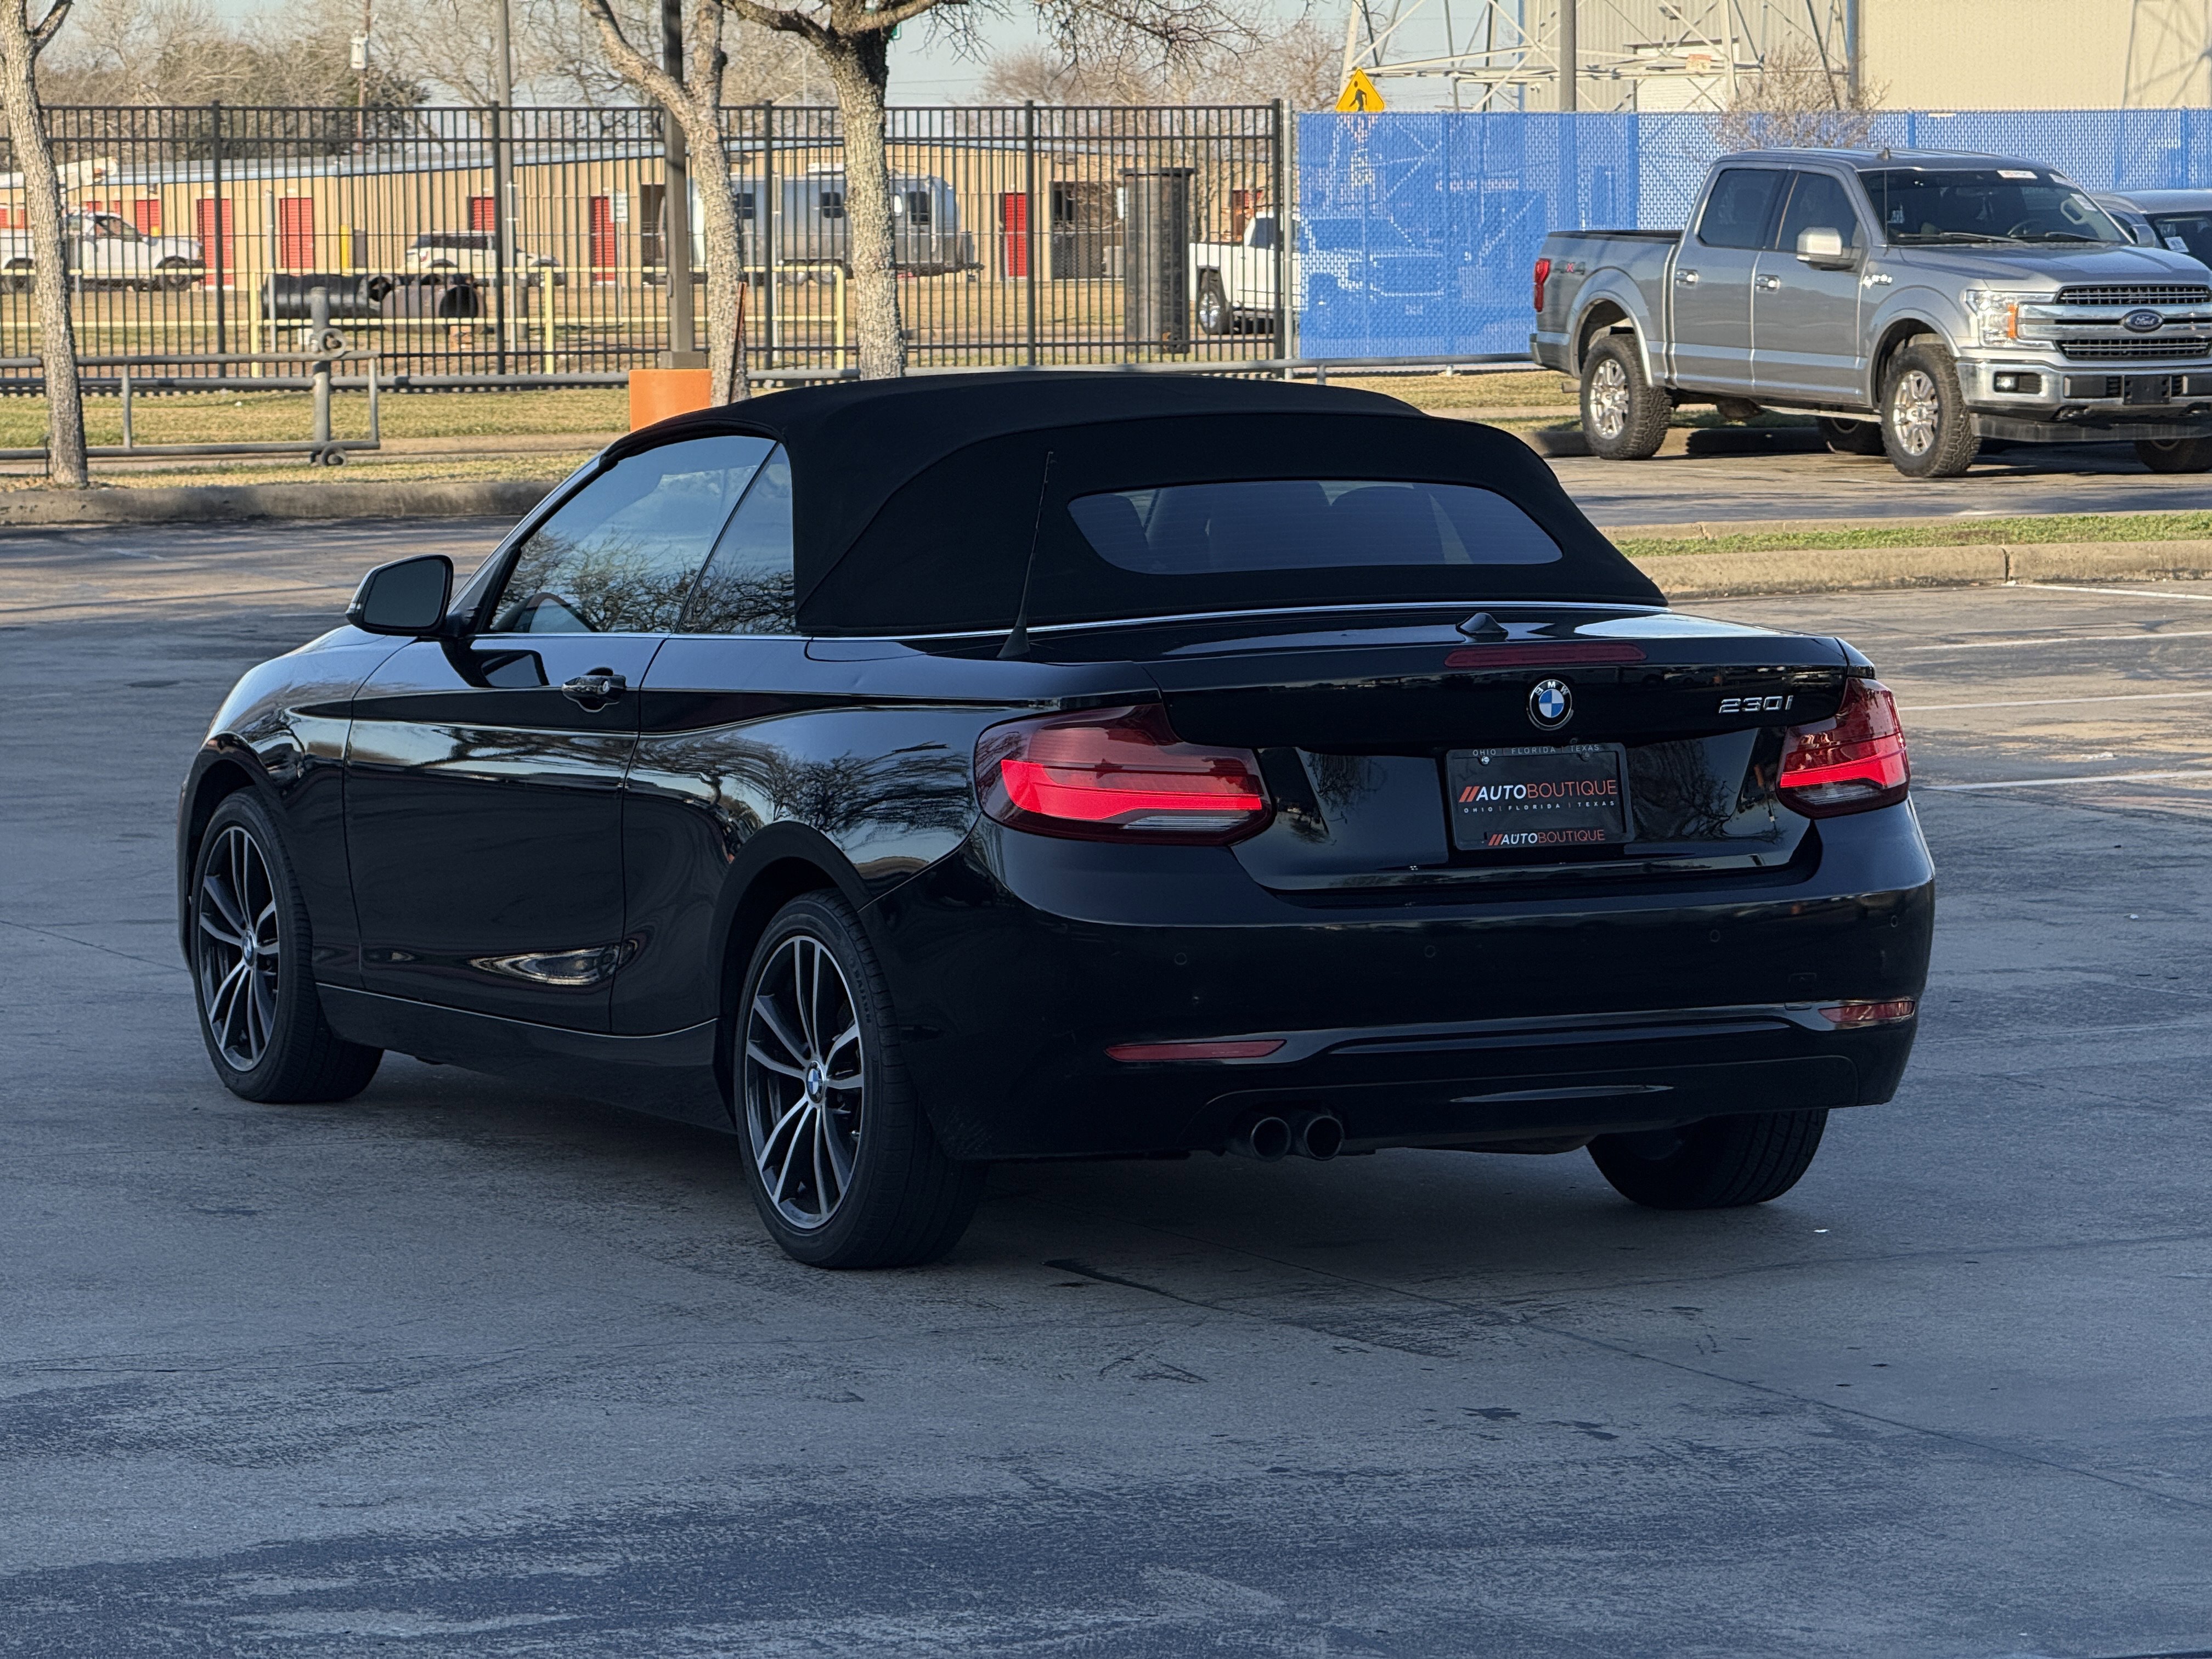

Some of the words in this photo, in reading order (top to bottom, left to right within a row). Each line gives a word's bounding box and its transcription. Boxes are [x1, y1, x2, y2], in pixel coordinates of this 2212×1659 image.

[1534, 681, 1570, 696] BMW
[1718, 695, 1794, 714] 230i
[1511, 747, 1556, 755] FLORIDA
[1570, 744, 1600, 753] TEXAS
[1475, 779, 1618, 802] AUTOBOUTIQUE
[1508, 803, 1560, 812] FLORIDA
[1500, 829, 1606, 845] AUTOBOUTIQUE
